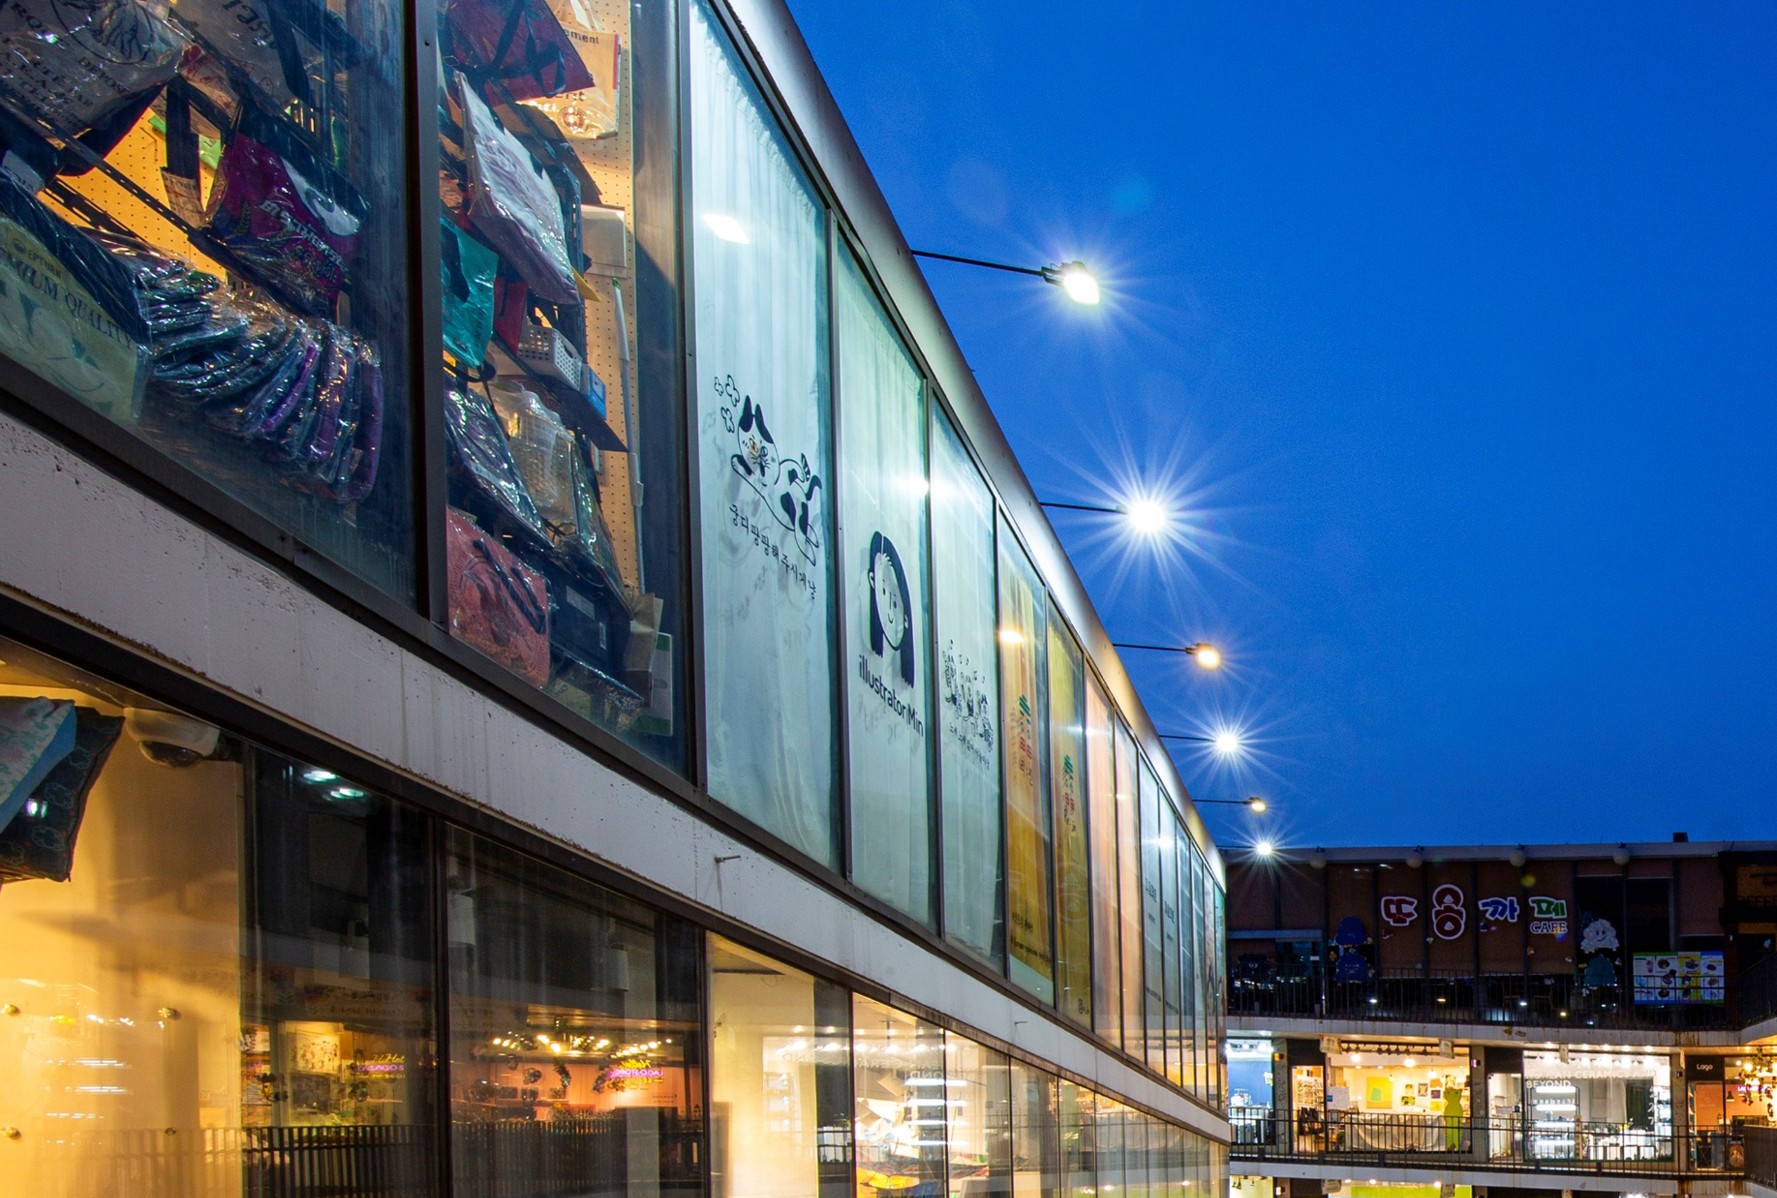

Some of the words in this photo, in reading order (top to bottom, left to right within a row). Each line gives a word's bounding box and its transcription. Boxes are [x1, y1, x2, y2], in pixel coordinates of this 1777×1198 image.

[858, 654, 907, 718] illustrator
[907, 703, 925, 738] Min
[1529, 921, 1568, 934] CAFE
[1526, 1080, 1572, 1089] BEYOND
